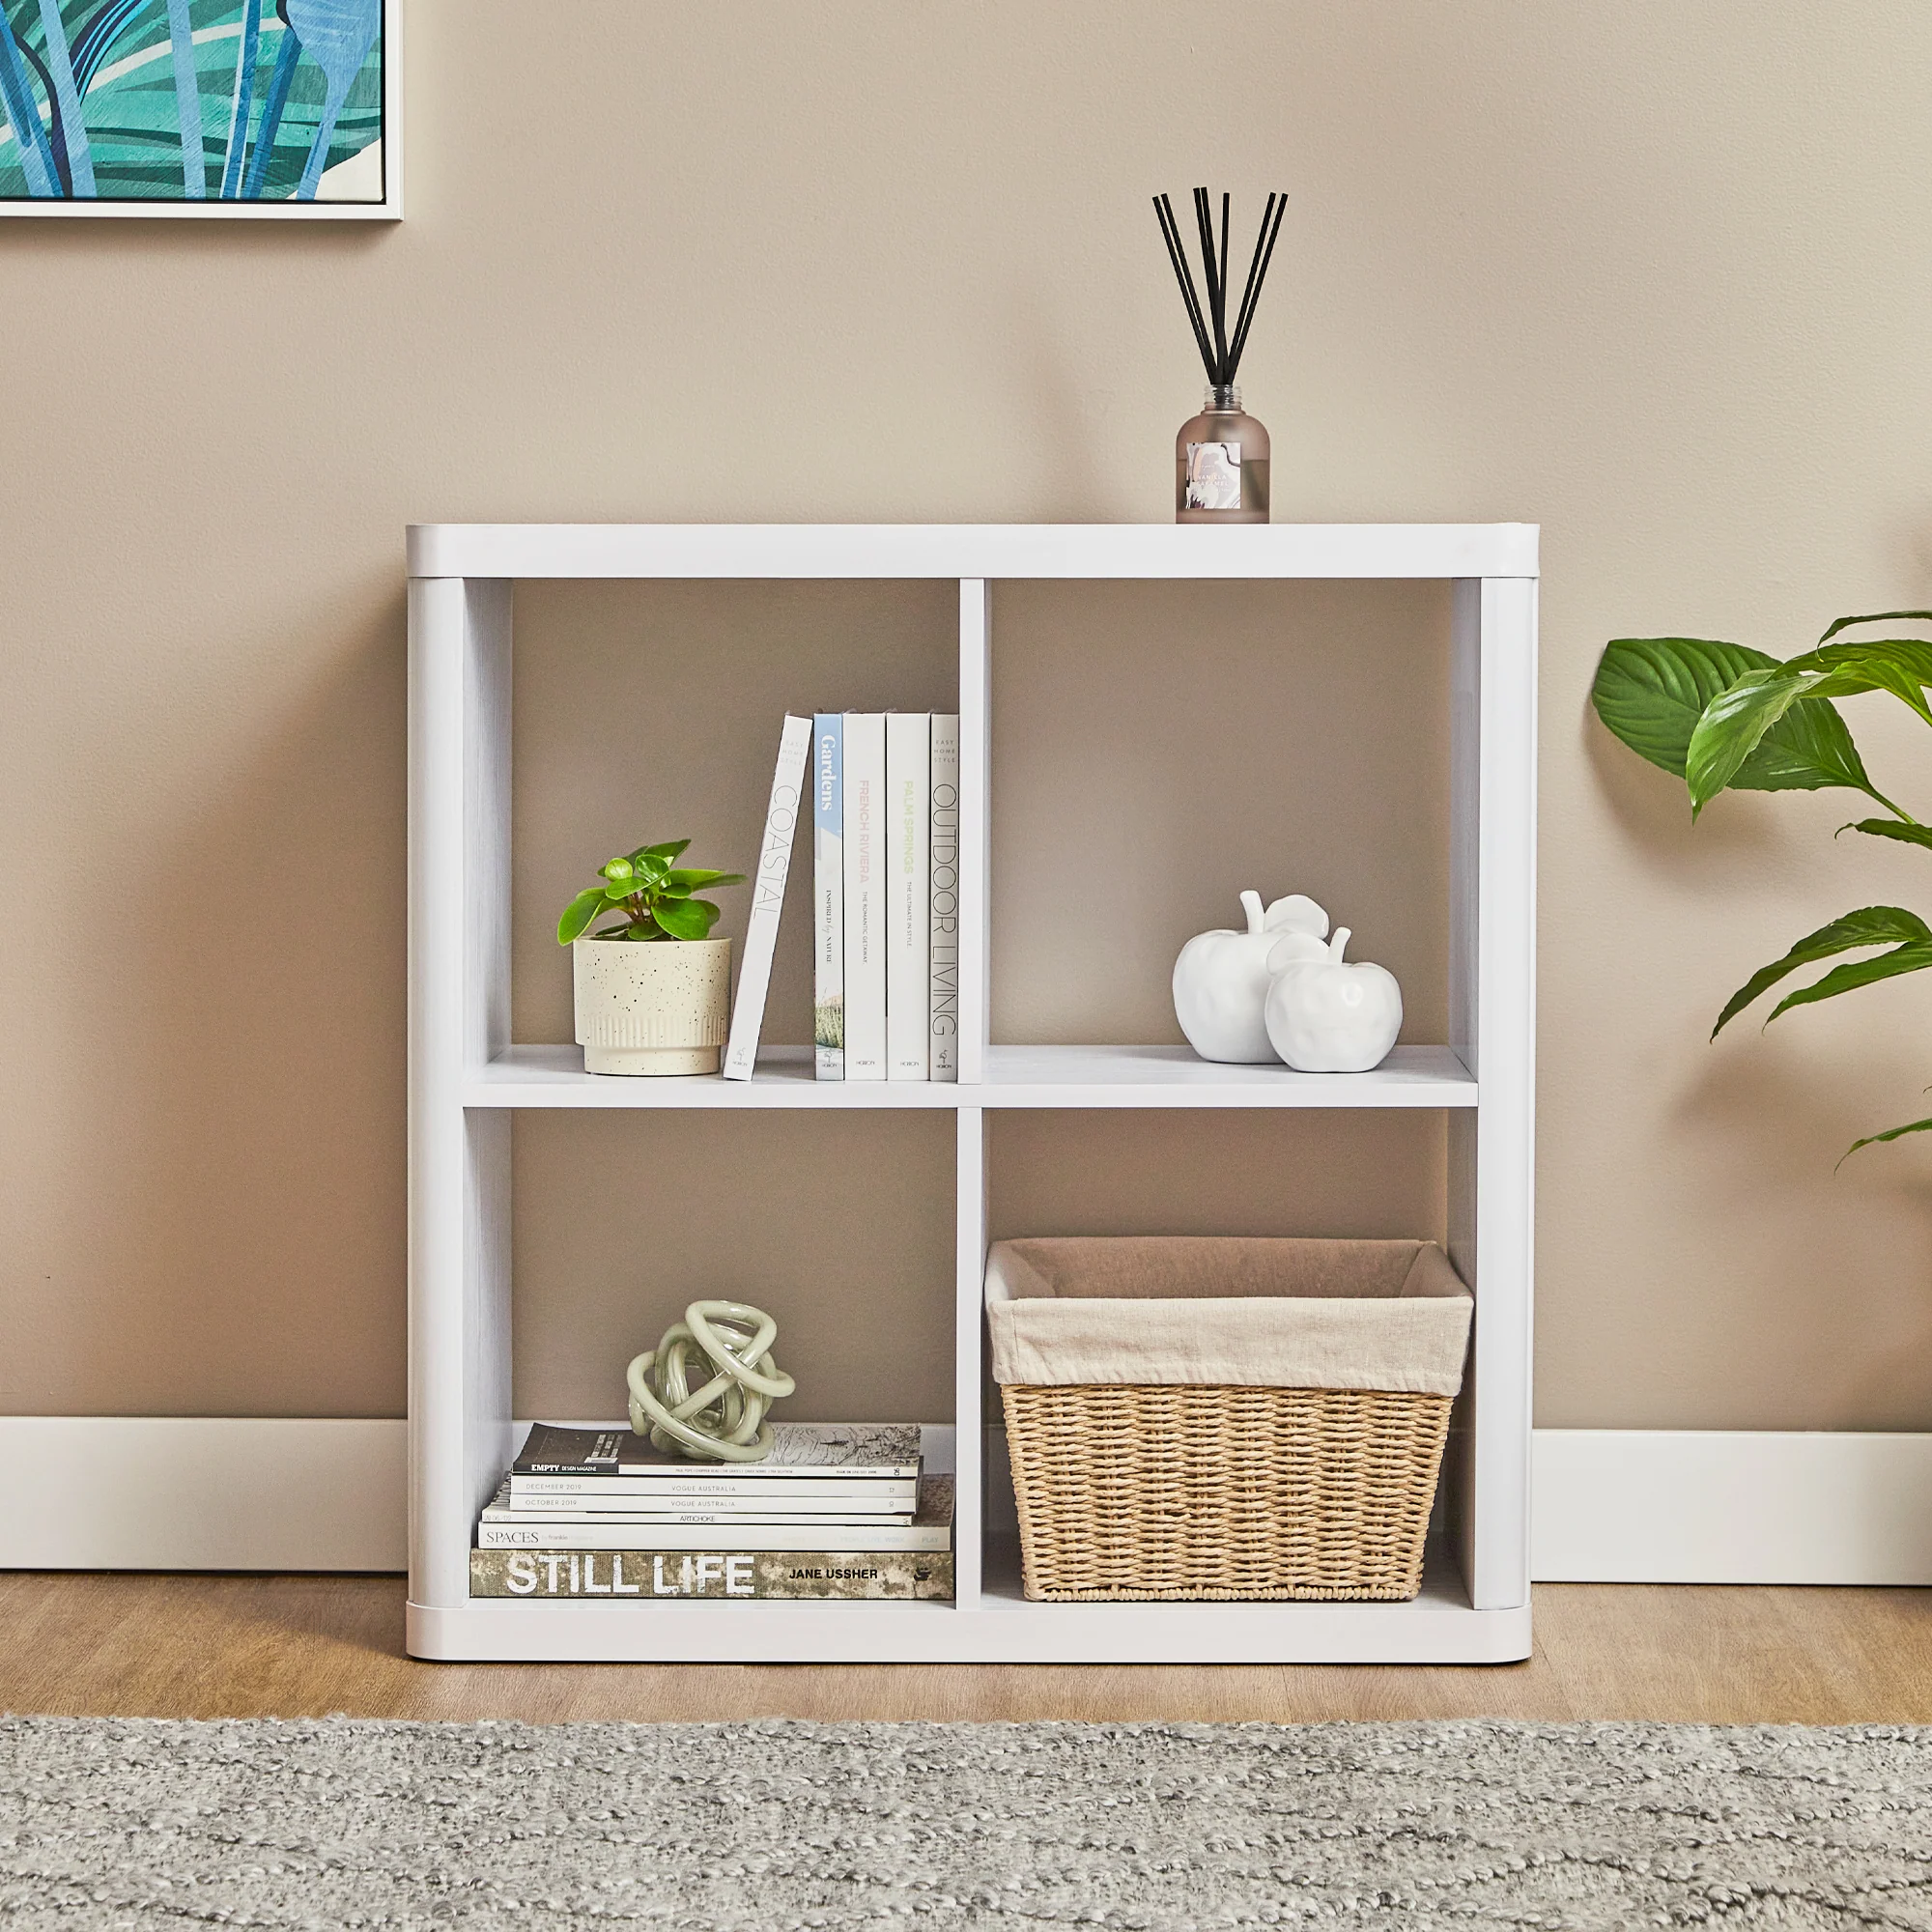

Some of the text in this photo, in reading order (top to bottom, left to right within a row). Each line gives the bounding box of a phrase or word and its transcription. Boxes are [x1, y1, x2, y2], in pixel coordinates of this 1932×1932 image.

[821, 734, 837, 811] Gardens
[753, 785, 798, 920] COASTAL
[859, 780, 869, 884] FRENCH RIVIERA
[903, 781, 914, 874] PALM SPRINGS
[821, 924, 834, 934] by
[932, 783, 956, 1035] OUTDOOR LIVING
[894, 1467, 900, 1476] 06
[486, 1531, 539, 1543] SPACES
[506, 1554, 754, 1595] STILL LIFE
[788, 1568, 878, 1579] JANE USSHER
